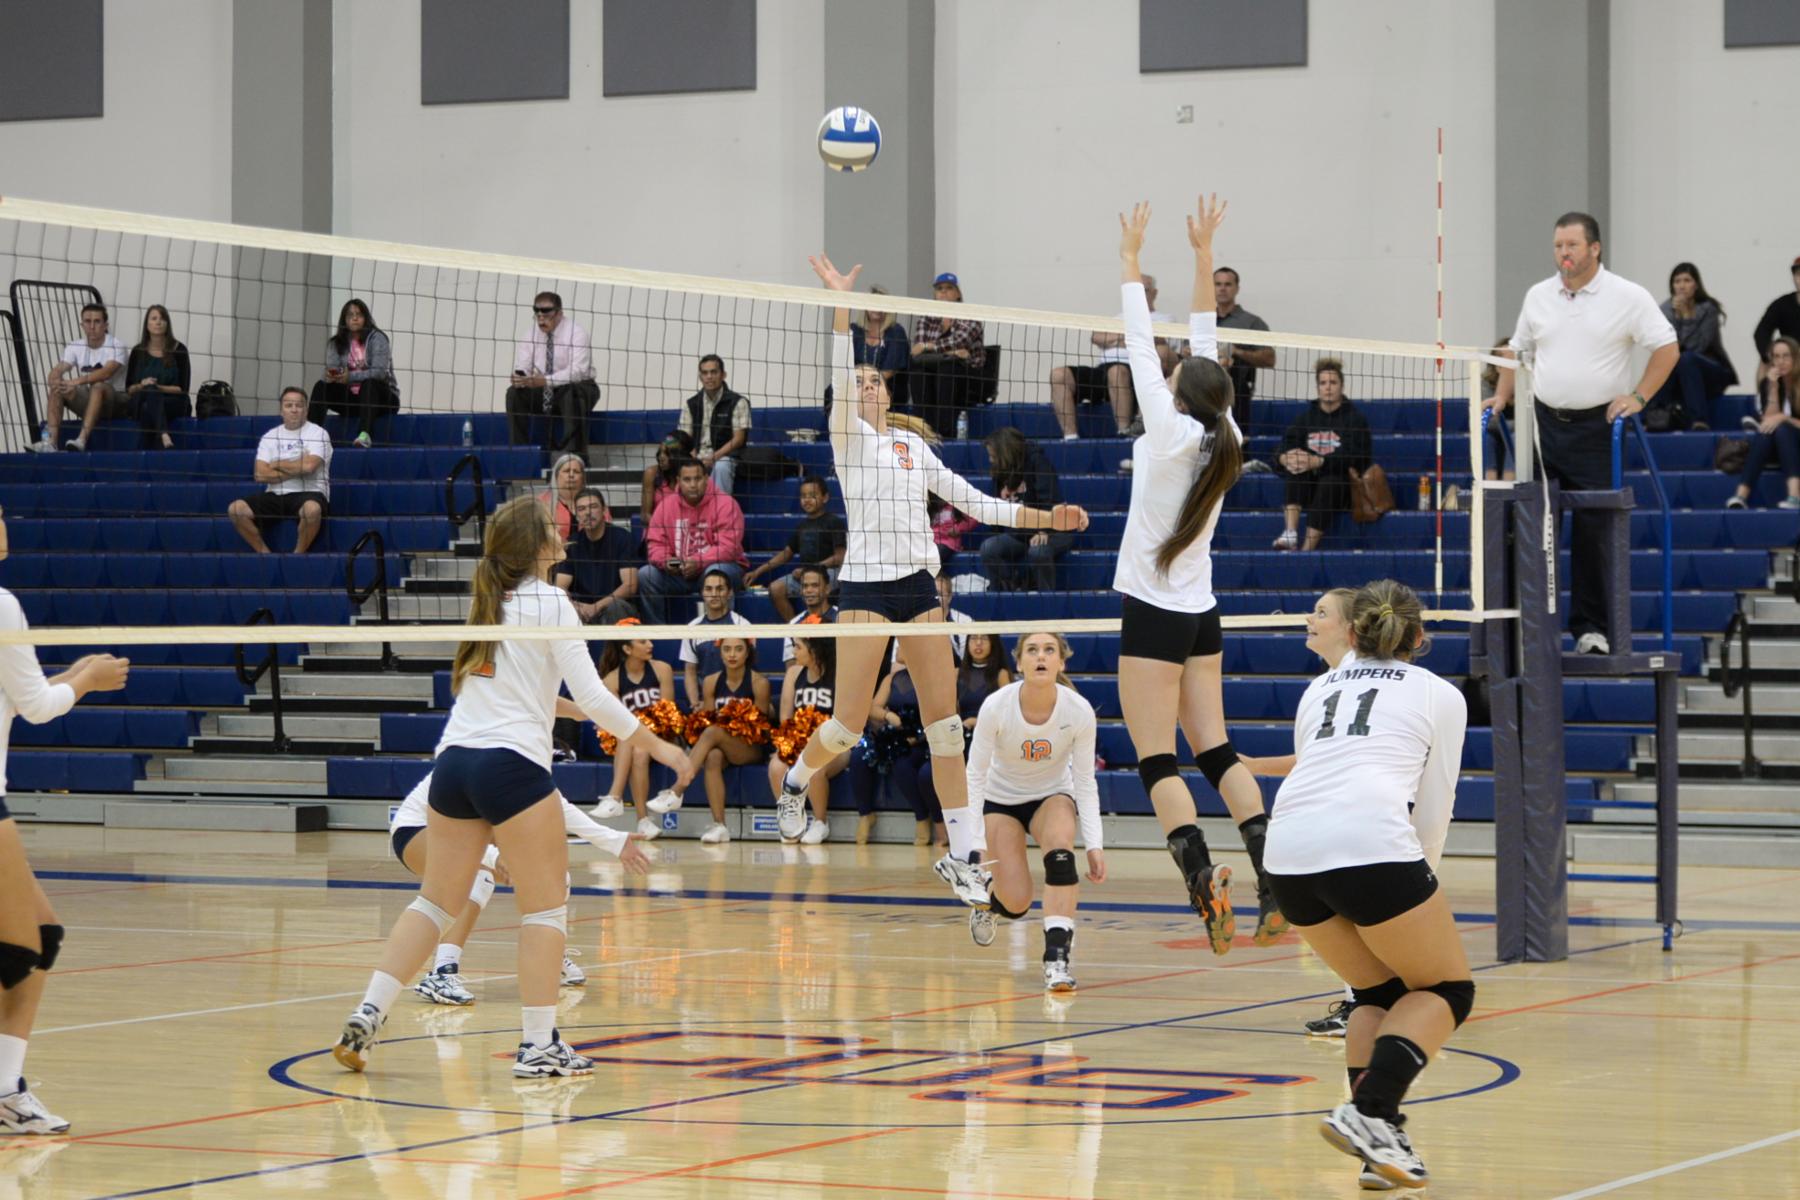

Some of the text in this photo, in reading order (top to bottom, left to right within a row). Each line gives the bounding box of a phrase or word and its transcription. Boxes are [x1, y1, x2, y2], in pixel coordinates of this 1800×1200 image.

[1320, 668, 1407, 687] JUMPERS
[622, 688, 660, 711] COS
[795, 687, 832, 708] COS
[1315, 688, 1379, 740] 11
[1021, 739, 1052, 762] 12
